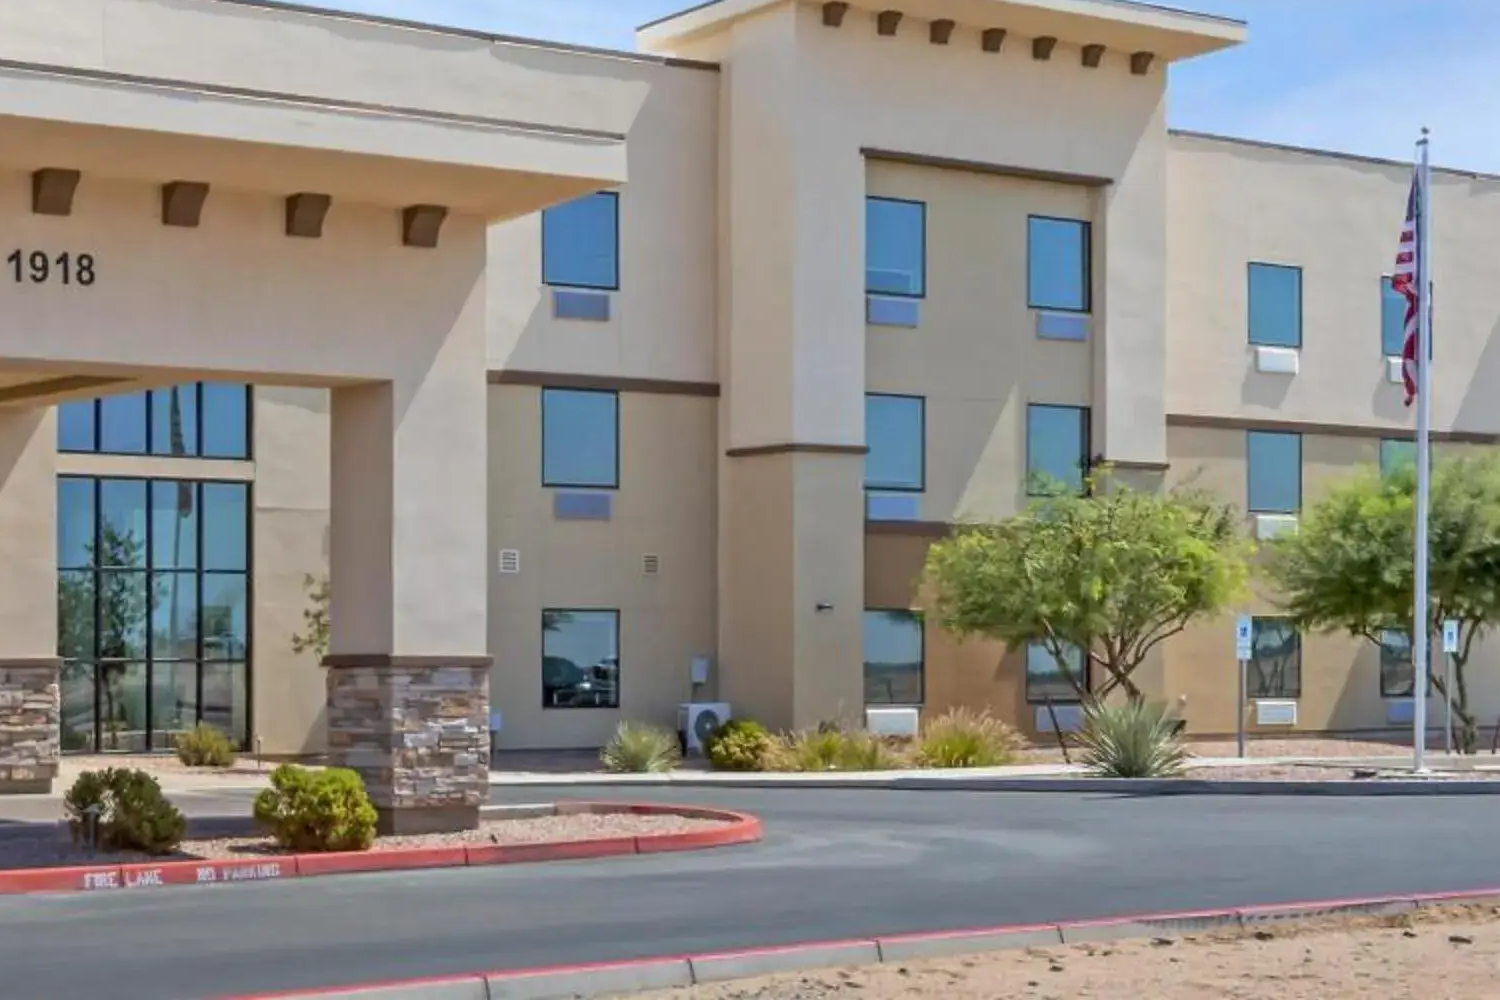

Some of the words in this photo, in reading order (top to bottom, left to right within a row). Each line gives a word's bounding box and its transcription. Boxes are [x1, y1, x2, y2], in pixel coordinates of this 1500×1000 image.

[7, 249, 95, 286] 1918
[84, 872, 119, 888] FIRE
[125, 869, 164, 887] LANE
